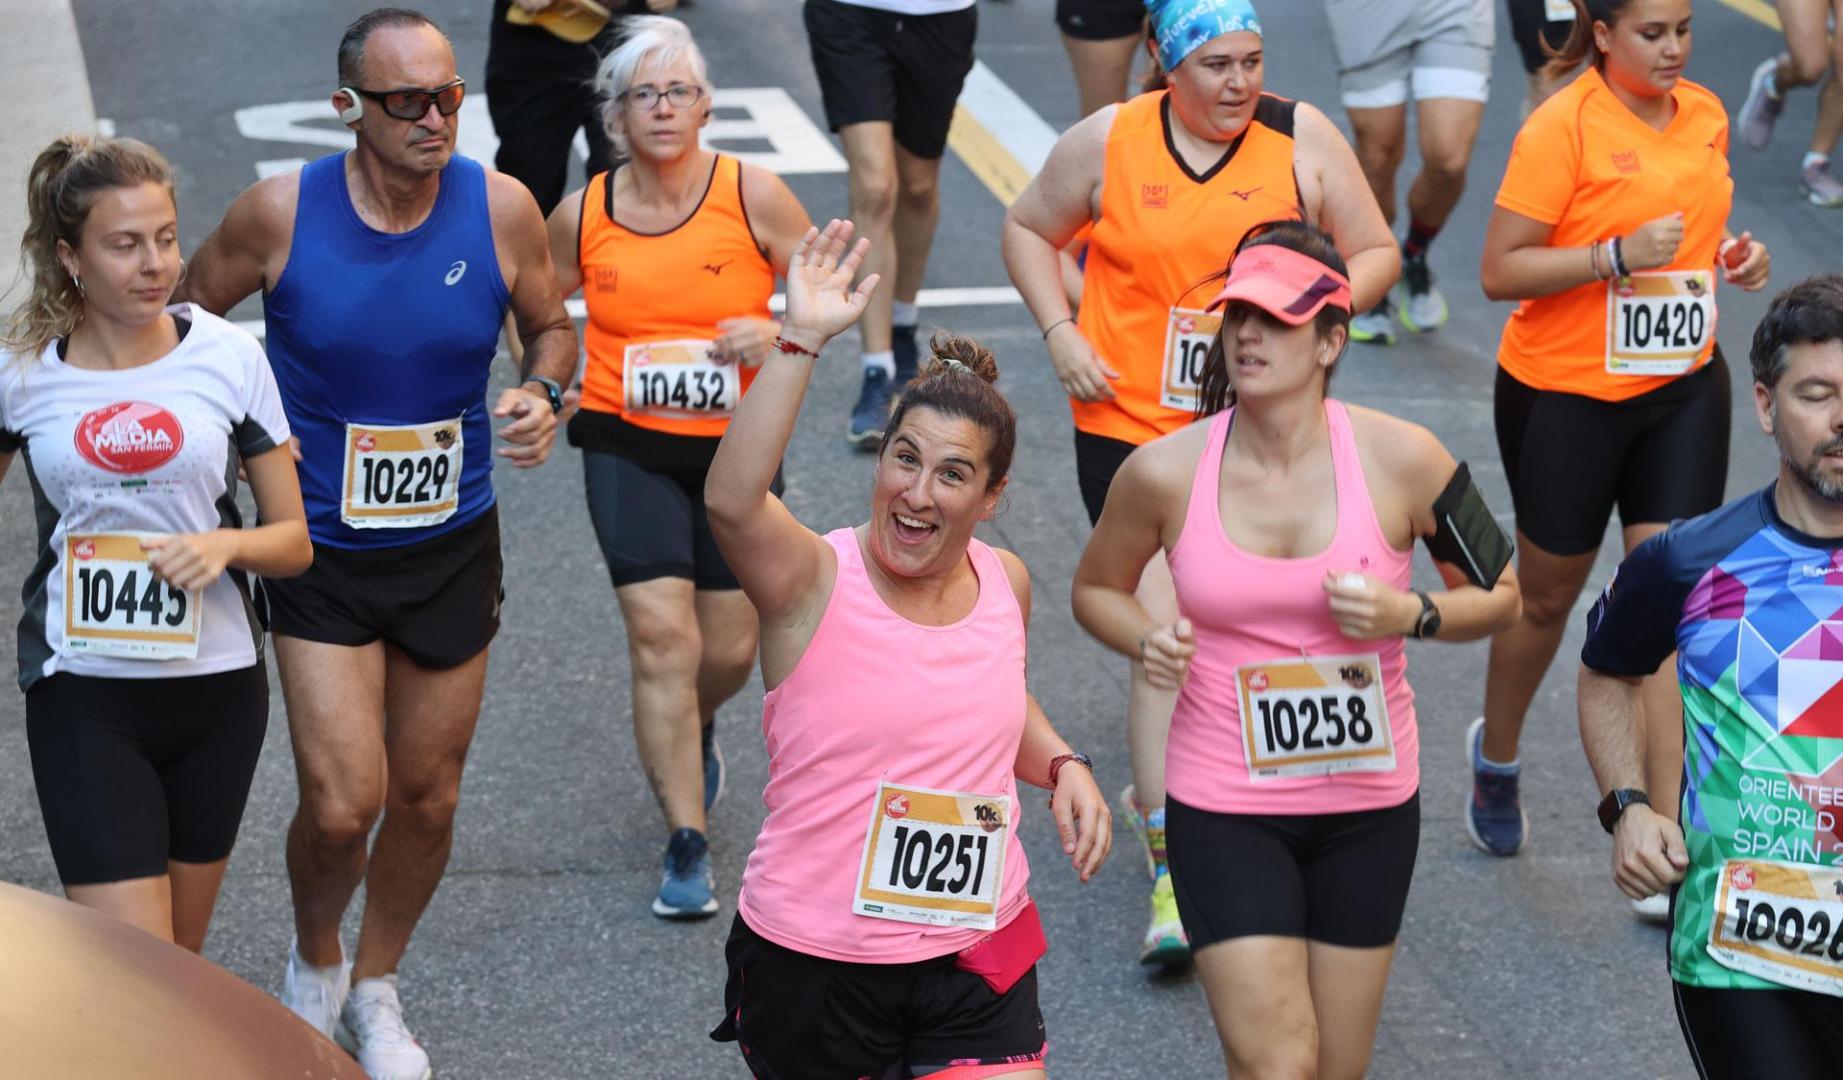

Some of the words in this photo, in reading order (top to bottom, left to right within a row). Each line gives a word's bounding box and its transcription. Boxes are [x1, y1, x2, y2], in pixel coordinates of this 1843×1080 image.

[1623, 302, 1704, 348] 10420
[1180, 339, 1209, 385] 10
[640, 371, 726, 410] 10432
[95, 428, 172, 449] MEDIA
[363, 453, 449, 504] 10229
[79, 568, 187, 627] 10445
[1258, 696, 1373, 753] 10258
[974, 804, 998, 822] 10k
[1738, 775, 1843, 806] ORIENTEE
[1737, 799, 1836, 833] WORLD
[889, 825, 989, 896] 10251
[1733, 828, 1823, 865] SPAIN
[1734, 898, 1843, 962] 10026
